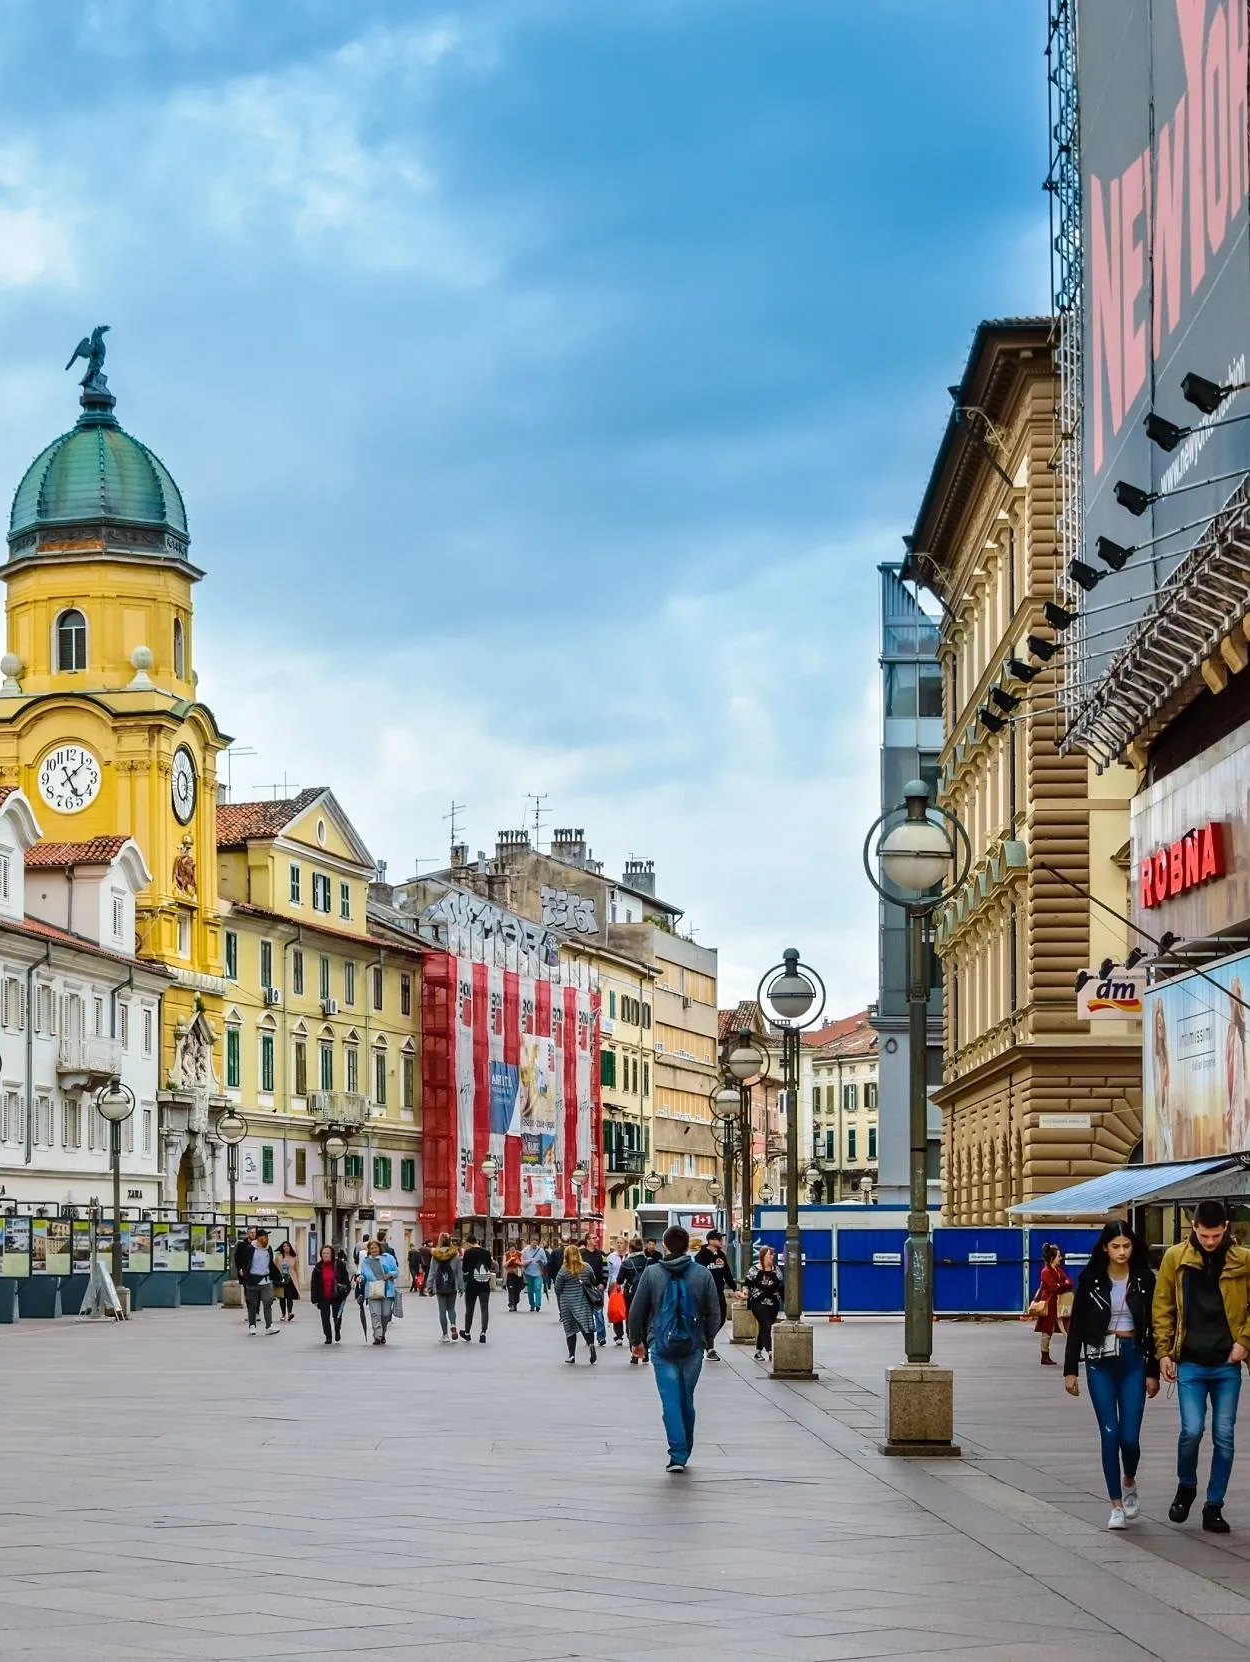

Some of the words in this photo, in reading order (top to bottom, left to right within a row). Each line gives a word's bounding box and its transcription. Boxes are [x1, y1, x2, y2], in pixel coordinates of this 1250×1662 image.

[57, 751, 63, 764] 11
[66, 749, 77, 761] 12
[80, 751, 85, 764] 1
[46, 759, 57, 771] 10
[85, 758, 92, 771] 2
[41, 773, 49, 785] 9
[90, 771, 98, 784] 3
[46, 786, 54, 799] 8
[85, 784, 92, 797] 4
[56, 795, 63, 807] 7
[65, 797, 73, 809] 6
[76, 795, 84, 806] 5
[1141, 823, 1221, 909] ROBNA
[1096, 979, 1135, 999] dm
[127, 1190, 143, 1199] ZARA
[694, 1215, 711, 1224] 1+1
